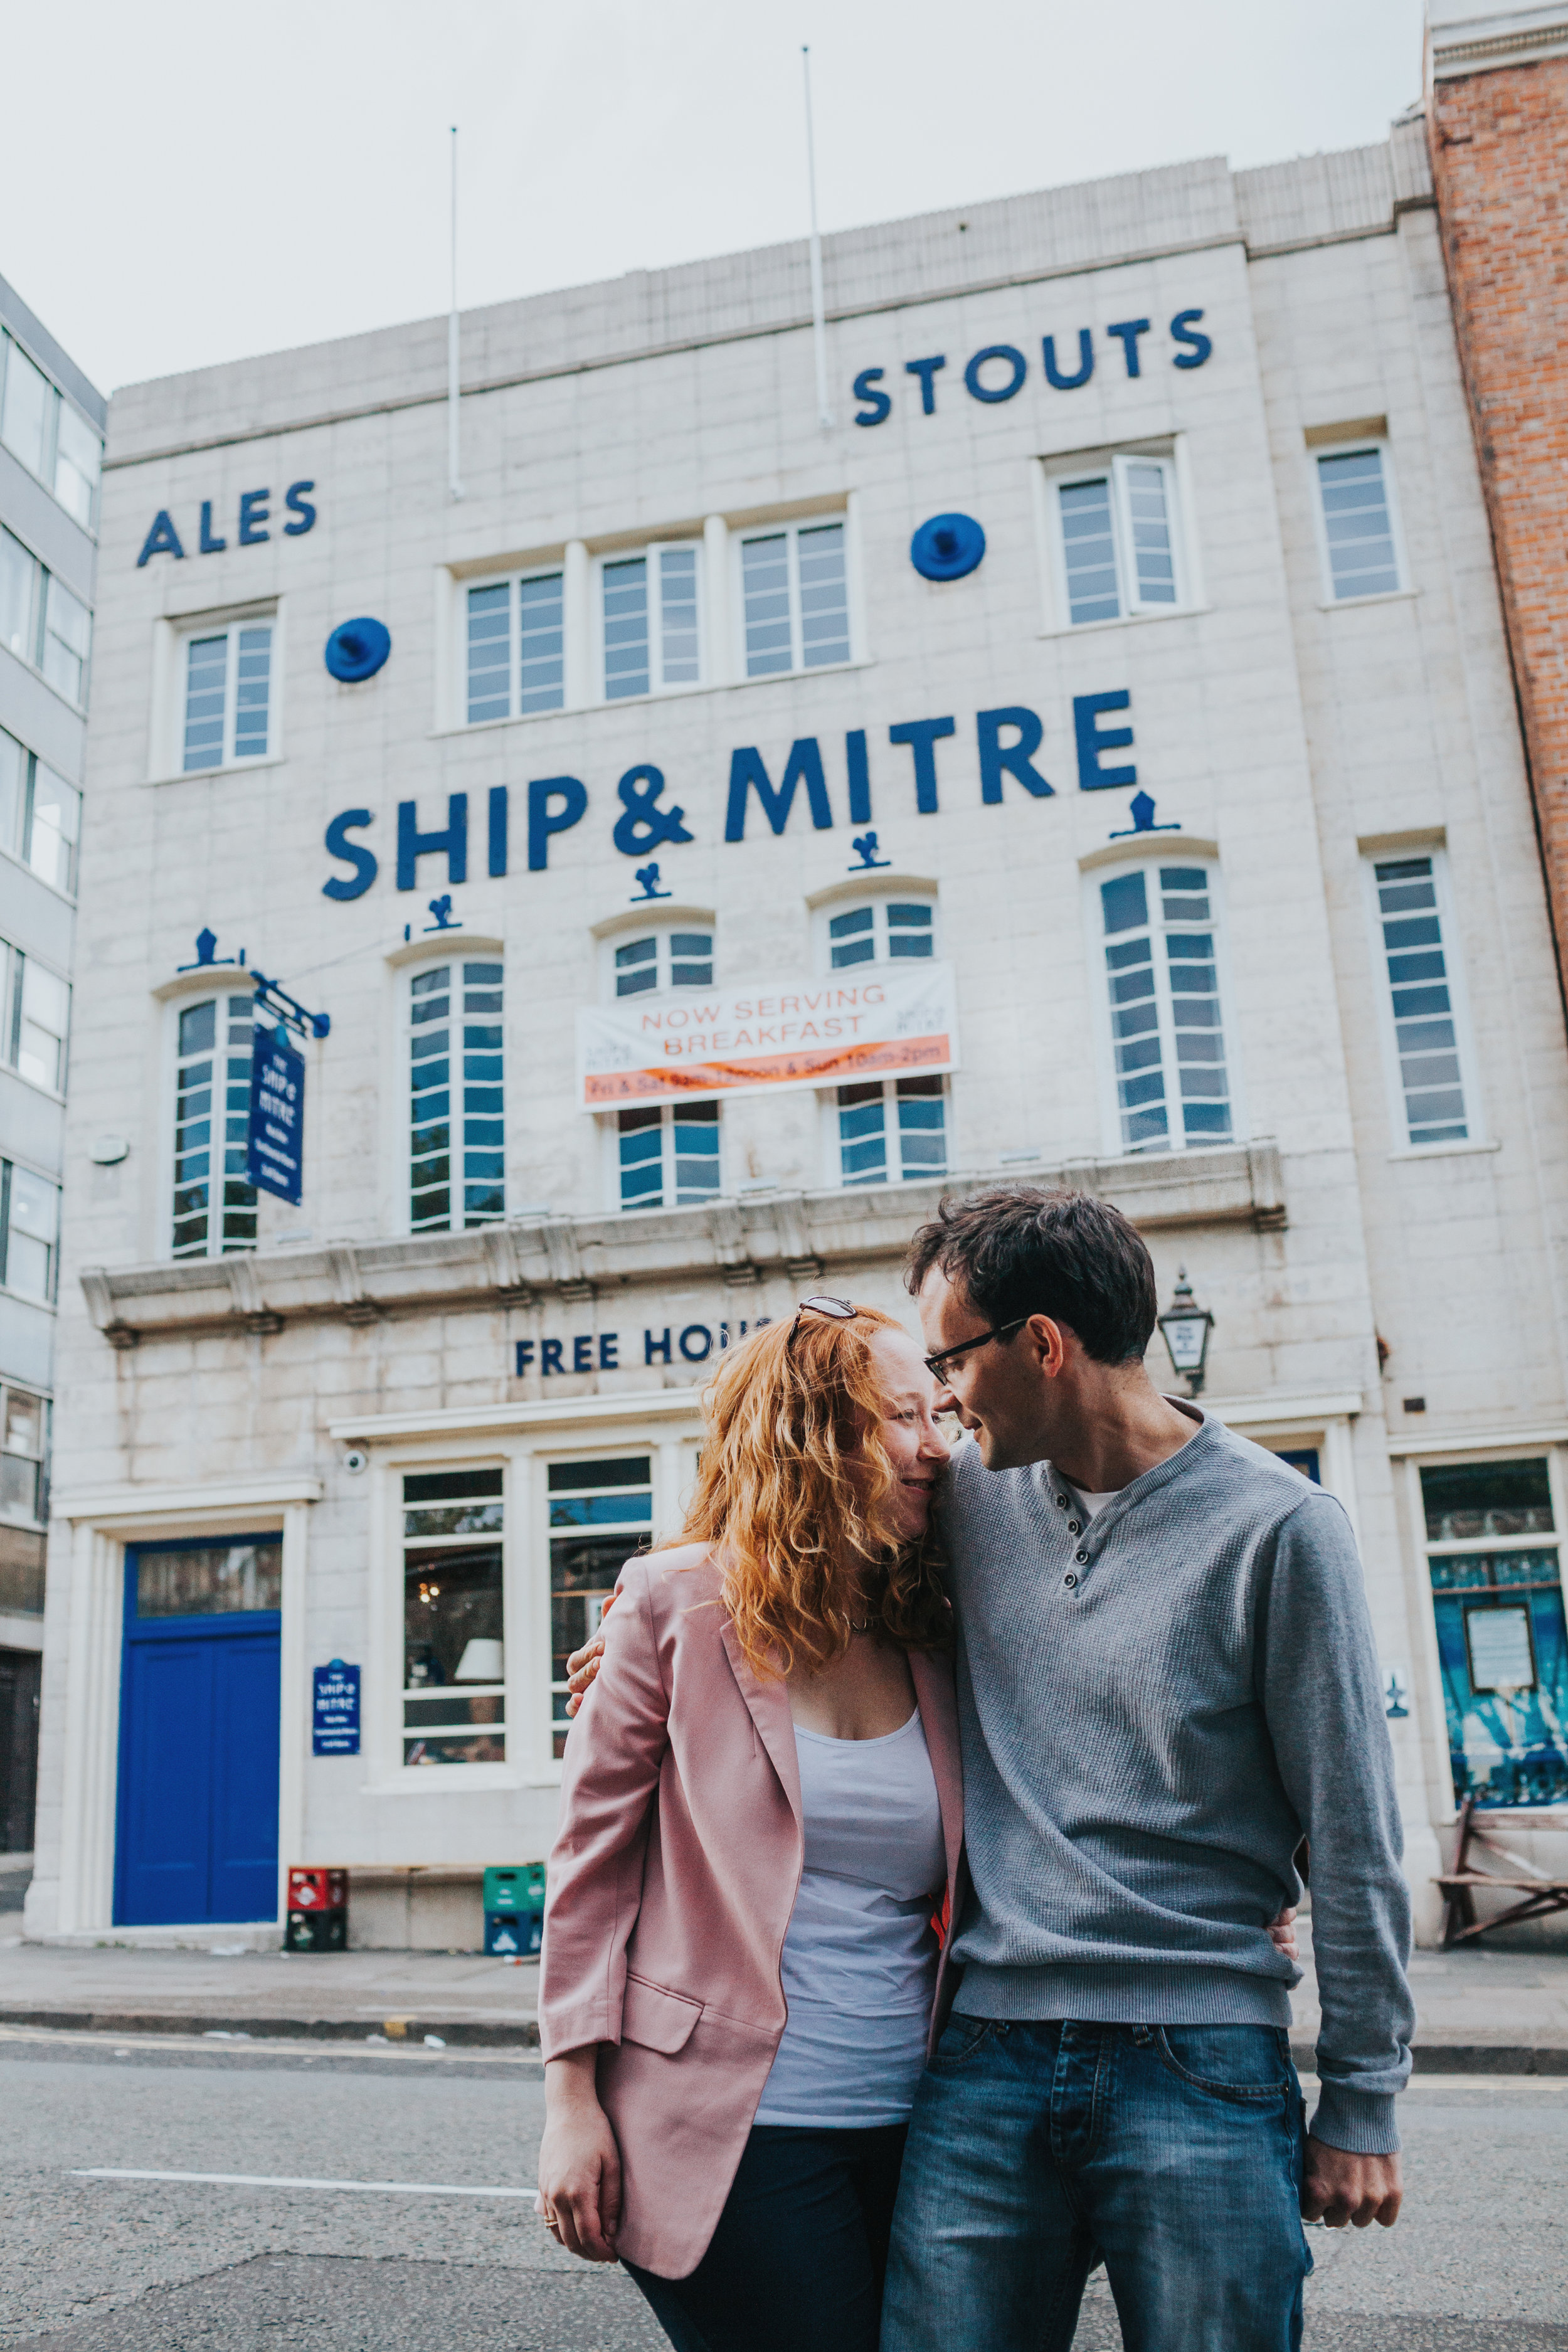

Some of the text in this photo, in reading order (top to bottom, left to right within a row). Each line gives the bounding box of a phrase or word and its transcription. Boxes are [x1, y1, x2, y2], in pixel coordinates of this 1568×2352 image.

[853, 309, 1212, 426] STOUTS
[136, 480, 317, 568] ALES
[321, 688, 1138, 901] SHIP & MITRE
[642, 1005, 720, 1030] NOW
[734, 984, 886, 1020] SERVING
[664, 1014, 864, 1056] BREAKFAST
[590, 1079, 614, 1095] Fri
[637, 1074, 665, 1091] Sat
[805, 1056, 840, 1074] Sun
[259, 1089, 295, 1128] MITRE
[515, 1317, 773, 1378] FREE HOU
